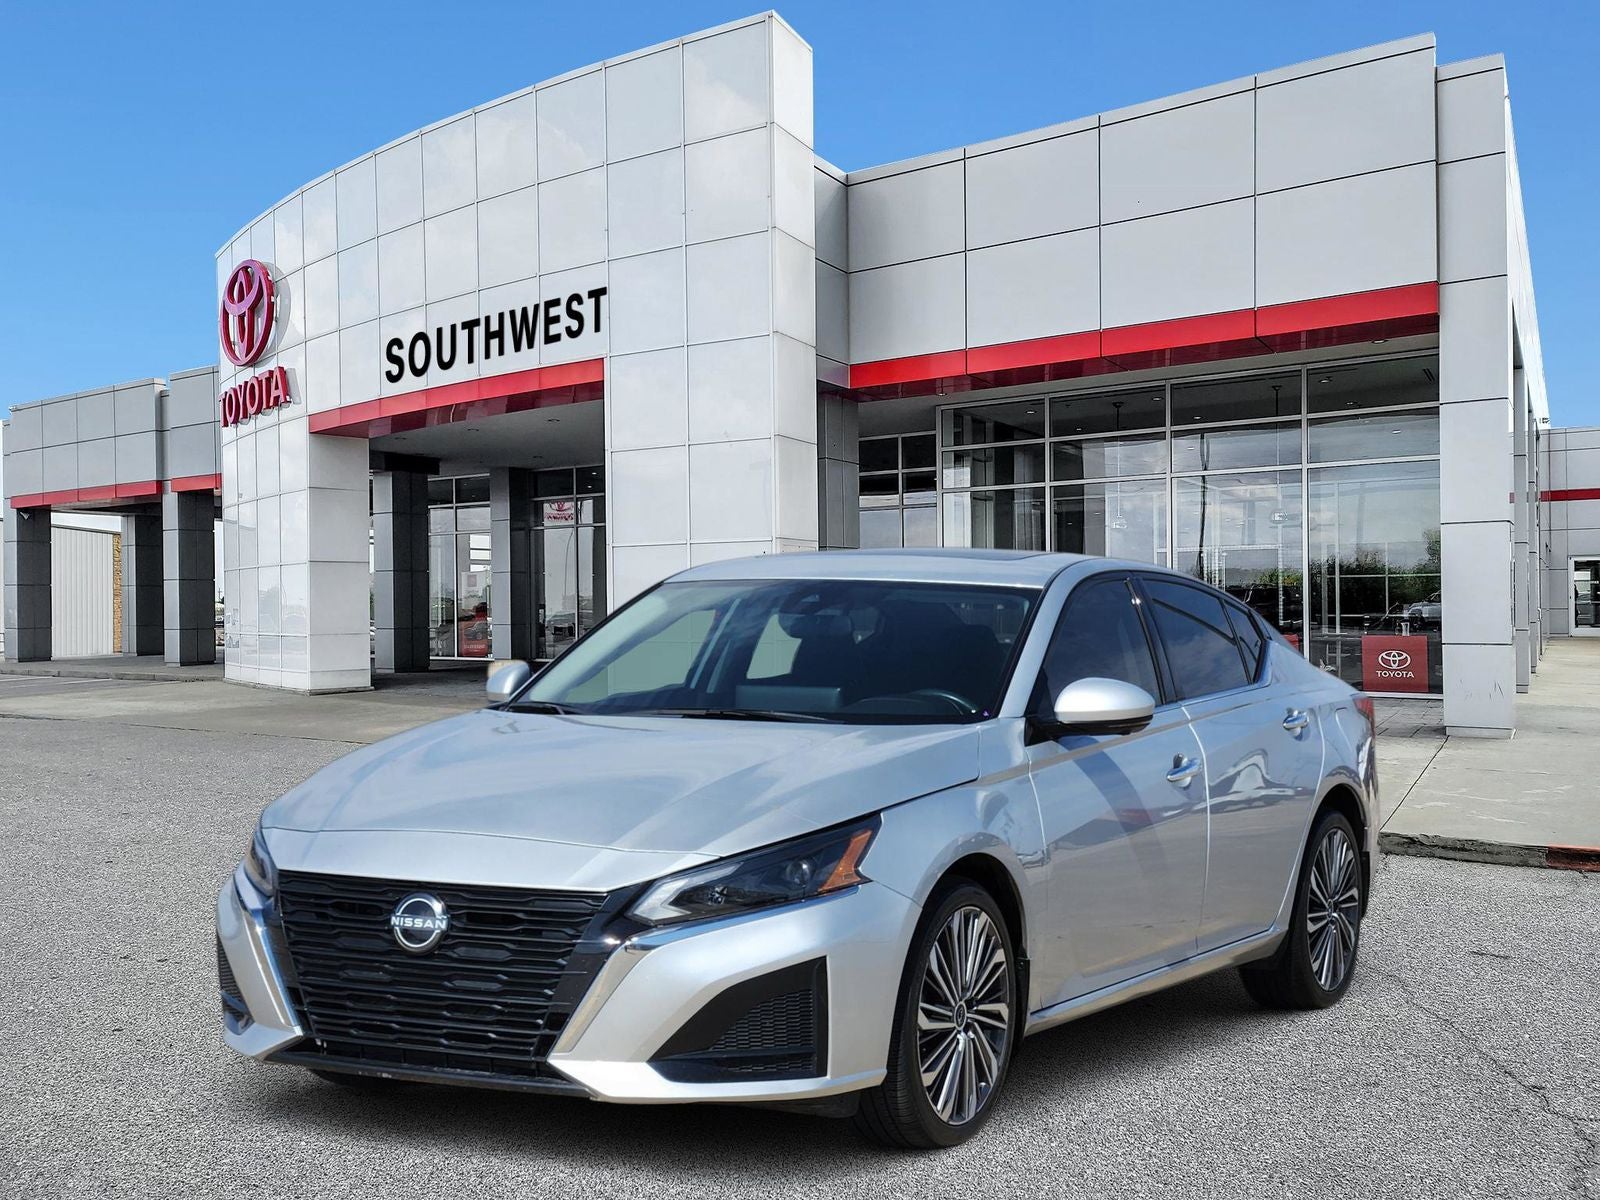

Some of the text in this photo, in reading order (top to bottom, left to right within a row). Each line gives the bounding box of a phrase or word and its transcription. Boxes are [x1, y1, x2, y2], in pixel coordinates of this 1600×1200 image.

[385, 286, 607, 383] SOUTHWEST
[218, 366, 291, 427] TOYOTA
[1376, 670, 1415, 678] TOYOTA
[390, 916, 447, 929] NISSAN
